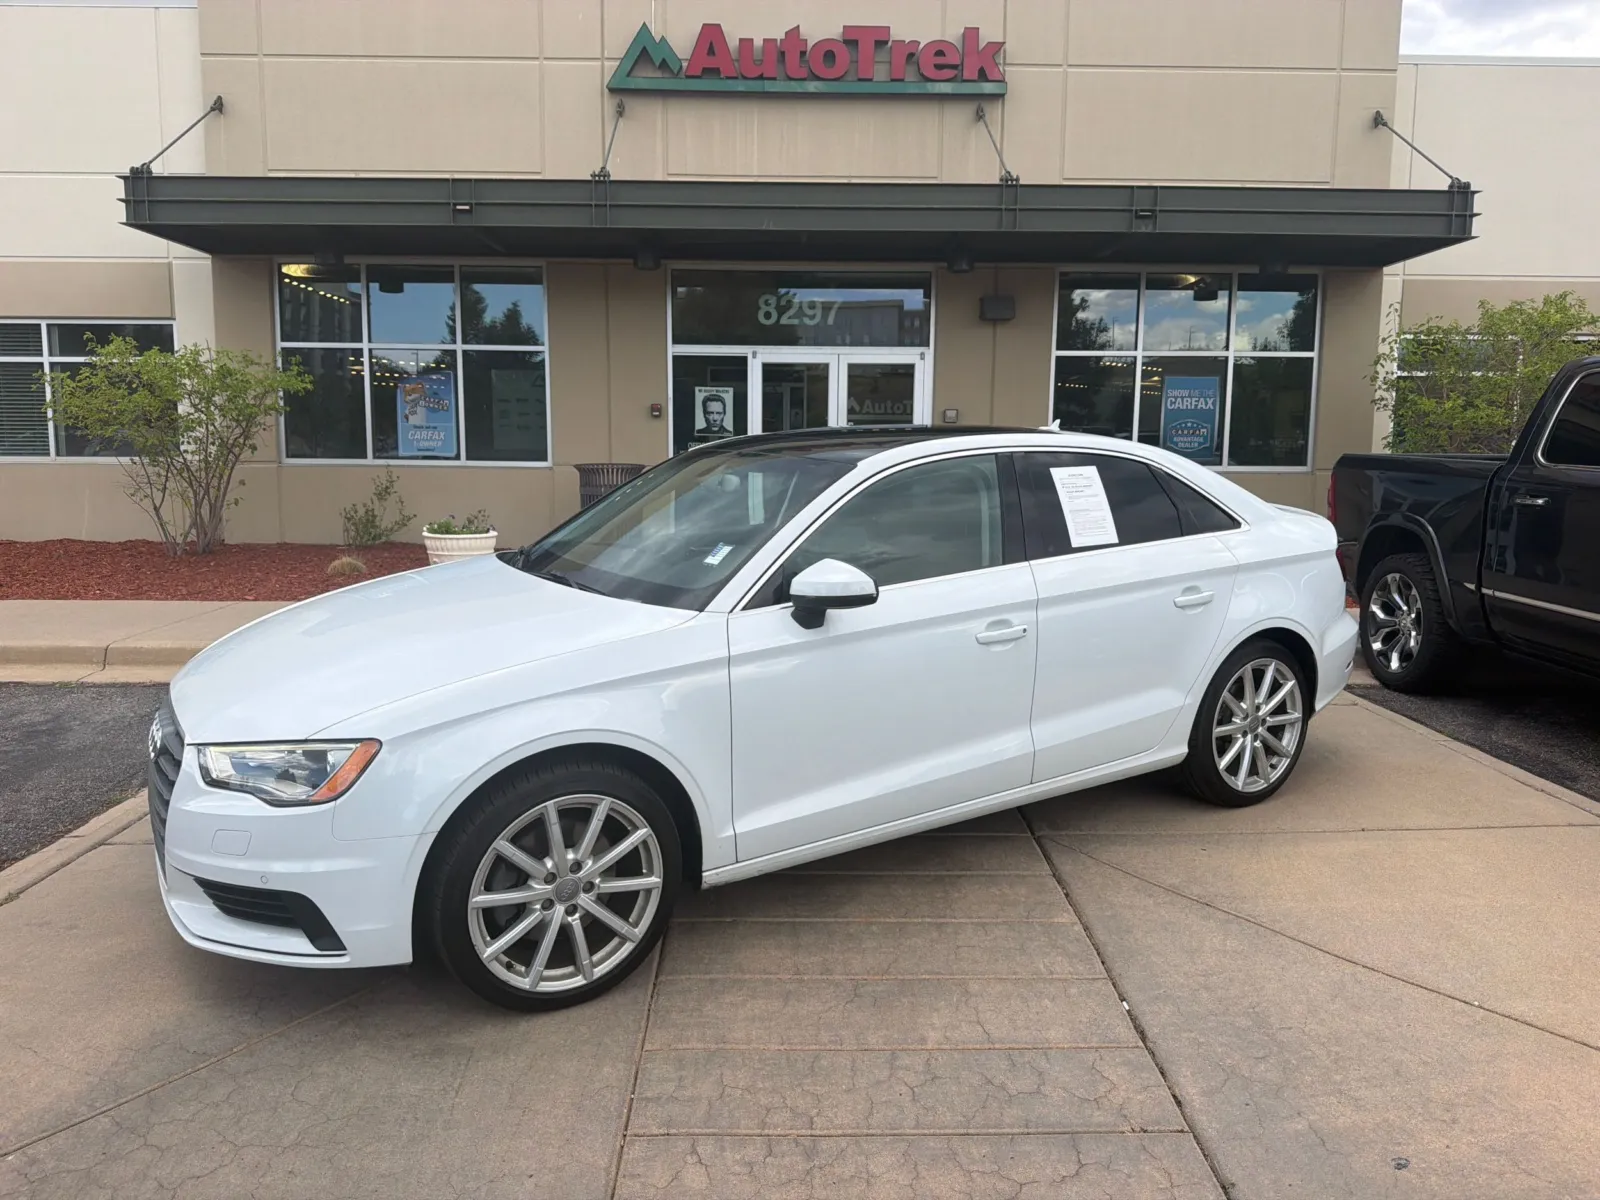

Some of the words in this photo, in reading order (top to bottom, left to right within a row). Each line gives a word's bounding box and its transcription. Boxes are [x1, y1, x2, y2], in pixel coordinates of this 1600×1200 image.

[684, 22, 1006, 82] AutoTrek
[757, 293, 843, 326] 8297
[1167, 389, 1190, 397] SHOW
[1191, 389, 1201, 397] ME
[1202, 389, 1215, 397] THE
[1167, 397, 1215, 410] CARFAX
[408, 431, 445, 440] CARFAX
